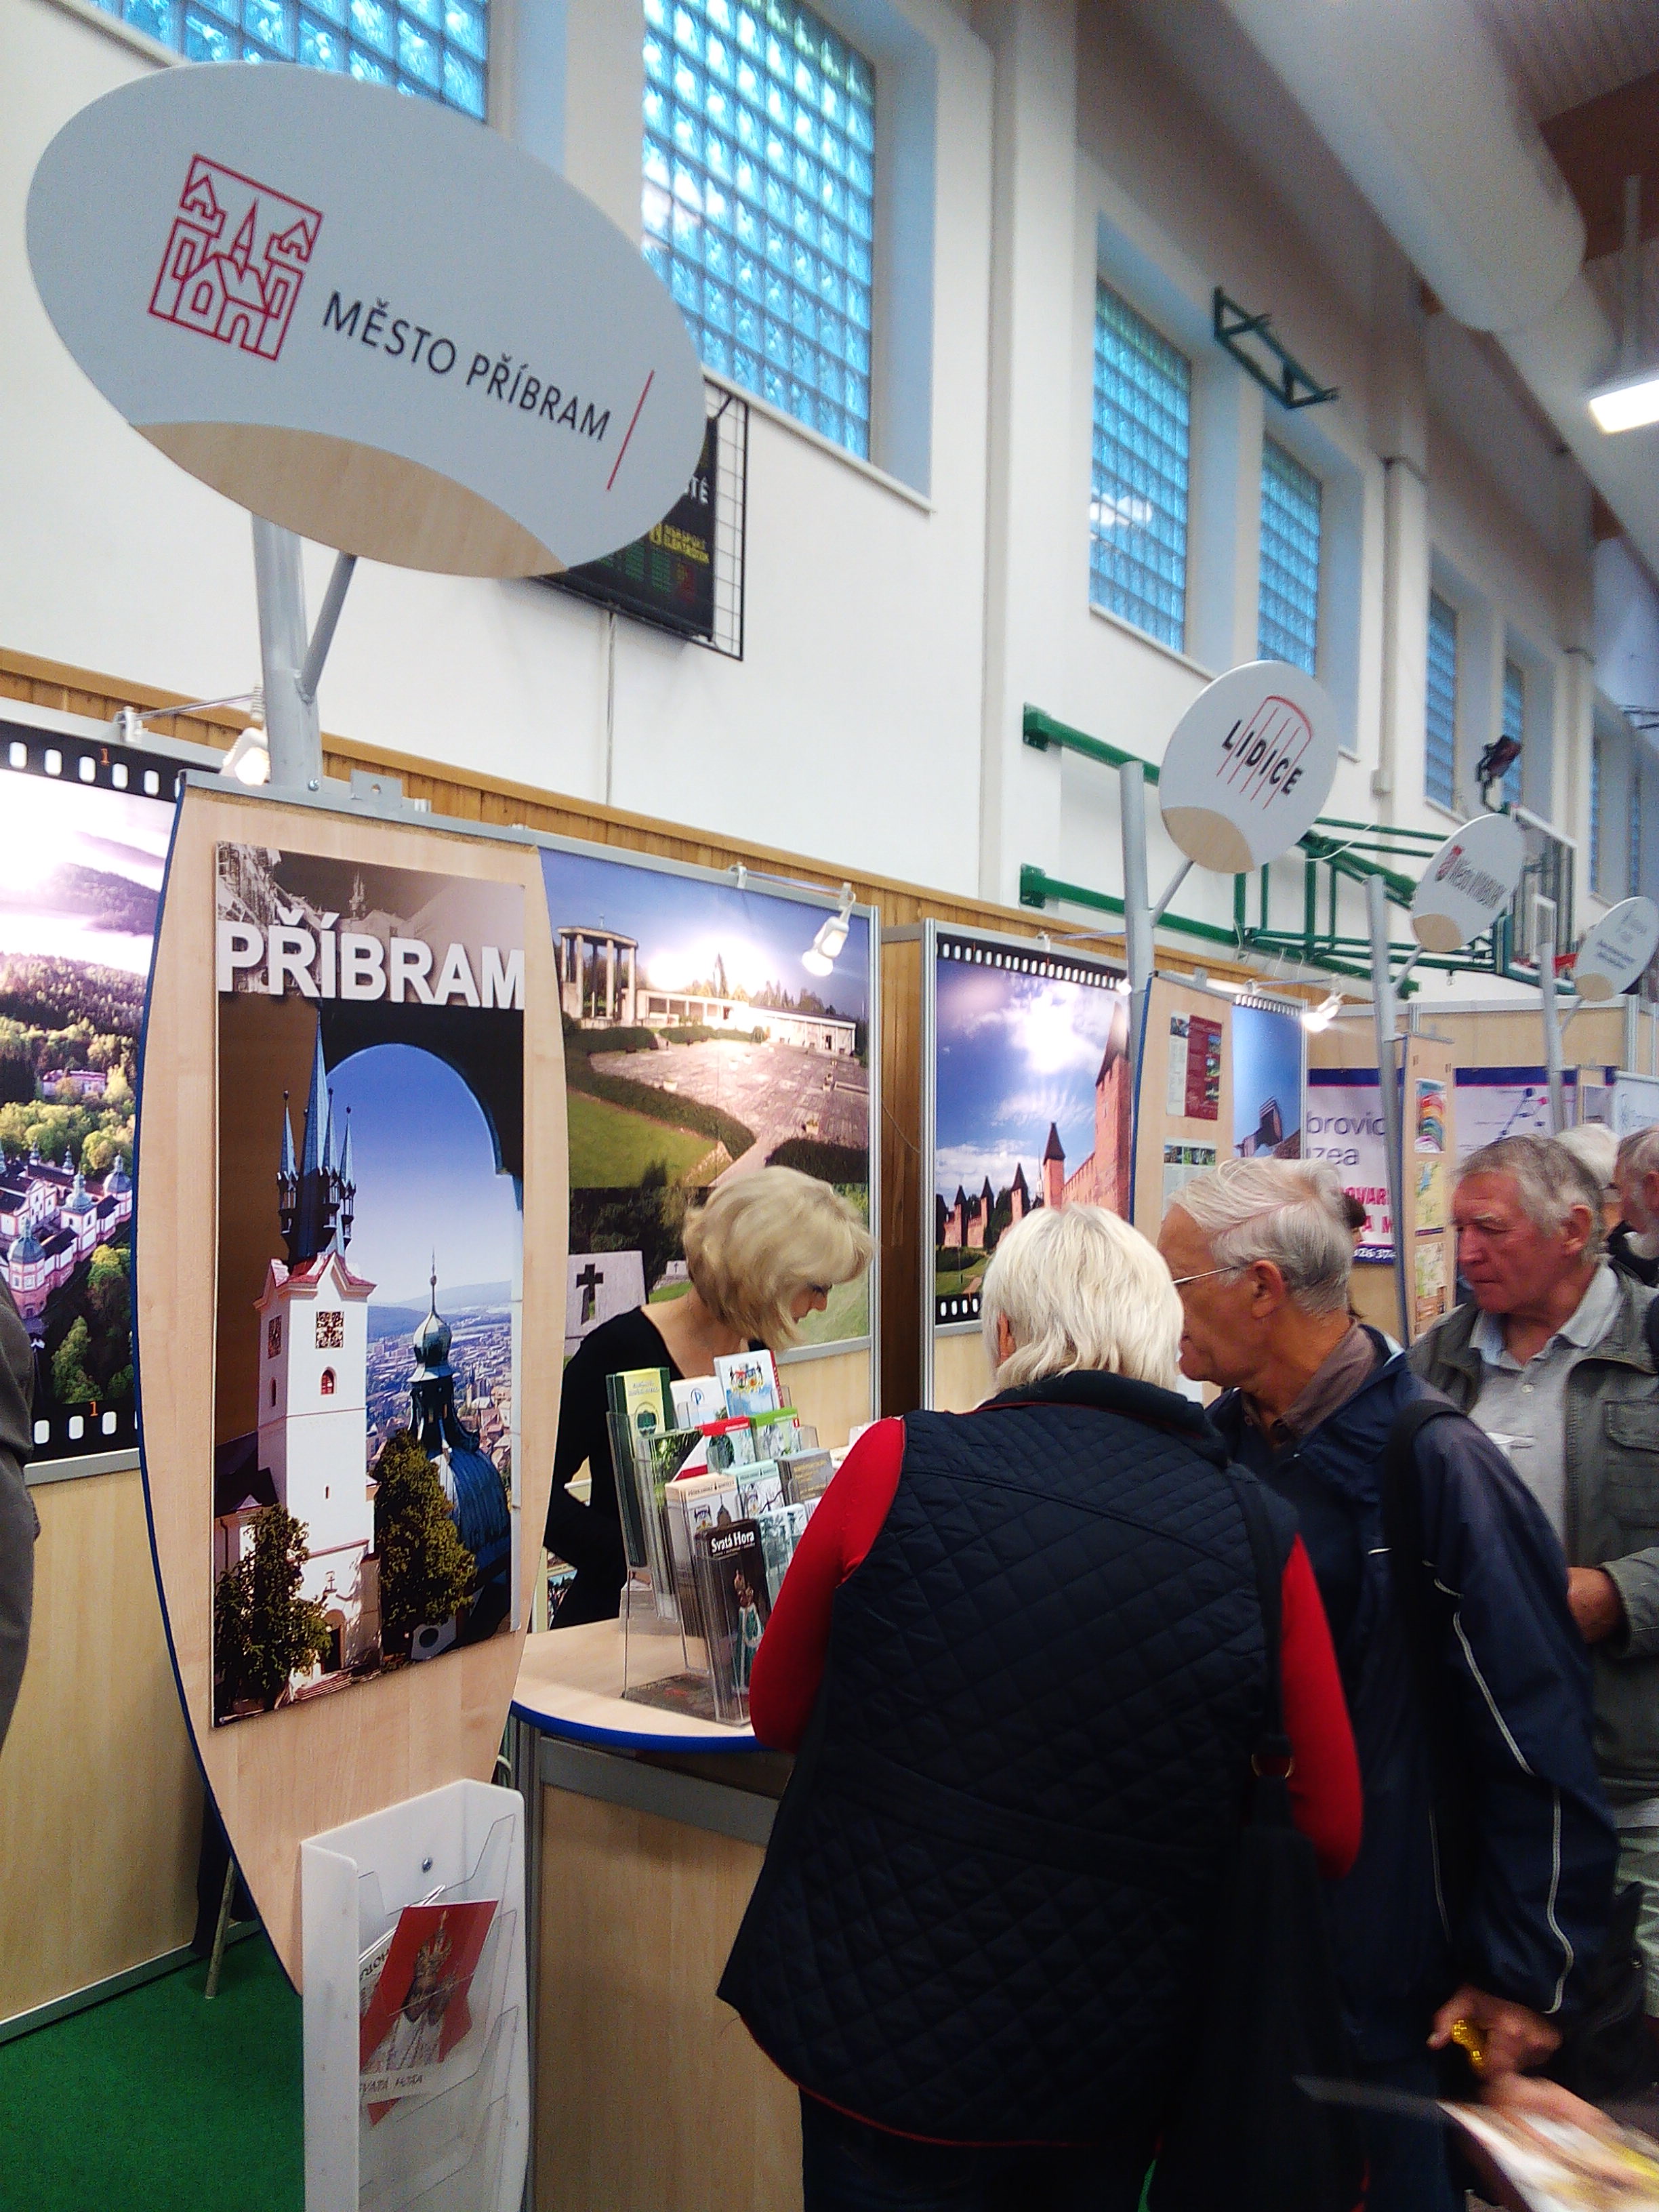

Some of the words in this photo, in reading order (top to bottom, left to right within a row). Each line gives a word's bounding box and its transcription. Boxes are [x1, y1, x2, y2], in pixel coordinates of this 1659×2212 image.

[322, 290, 457, 375] MĚSTO
[465, 352, 611, 442] PŘÍBRAM
[1221, 719, 1305, 796] LIDICE
[217, 906, 525, 1010] PŘÍBRAM
[1307, 1111, 1386, 1136] brovic
[89, 1401, 99, 1417] 1
[711, 1532, 733, 1553] Svatá
[733, 1530, 755, 1547] Hora
